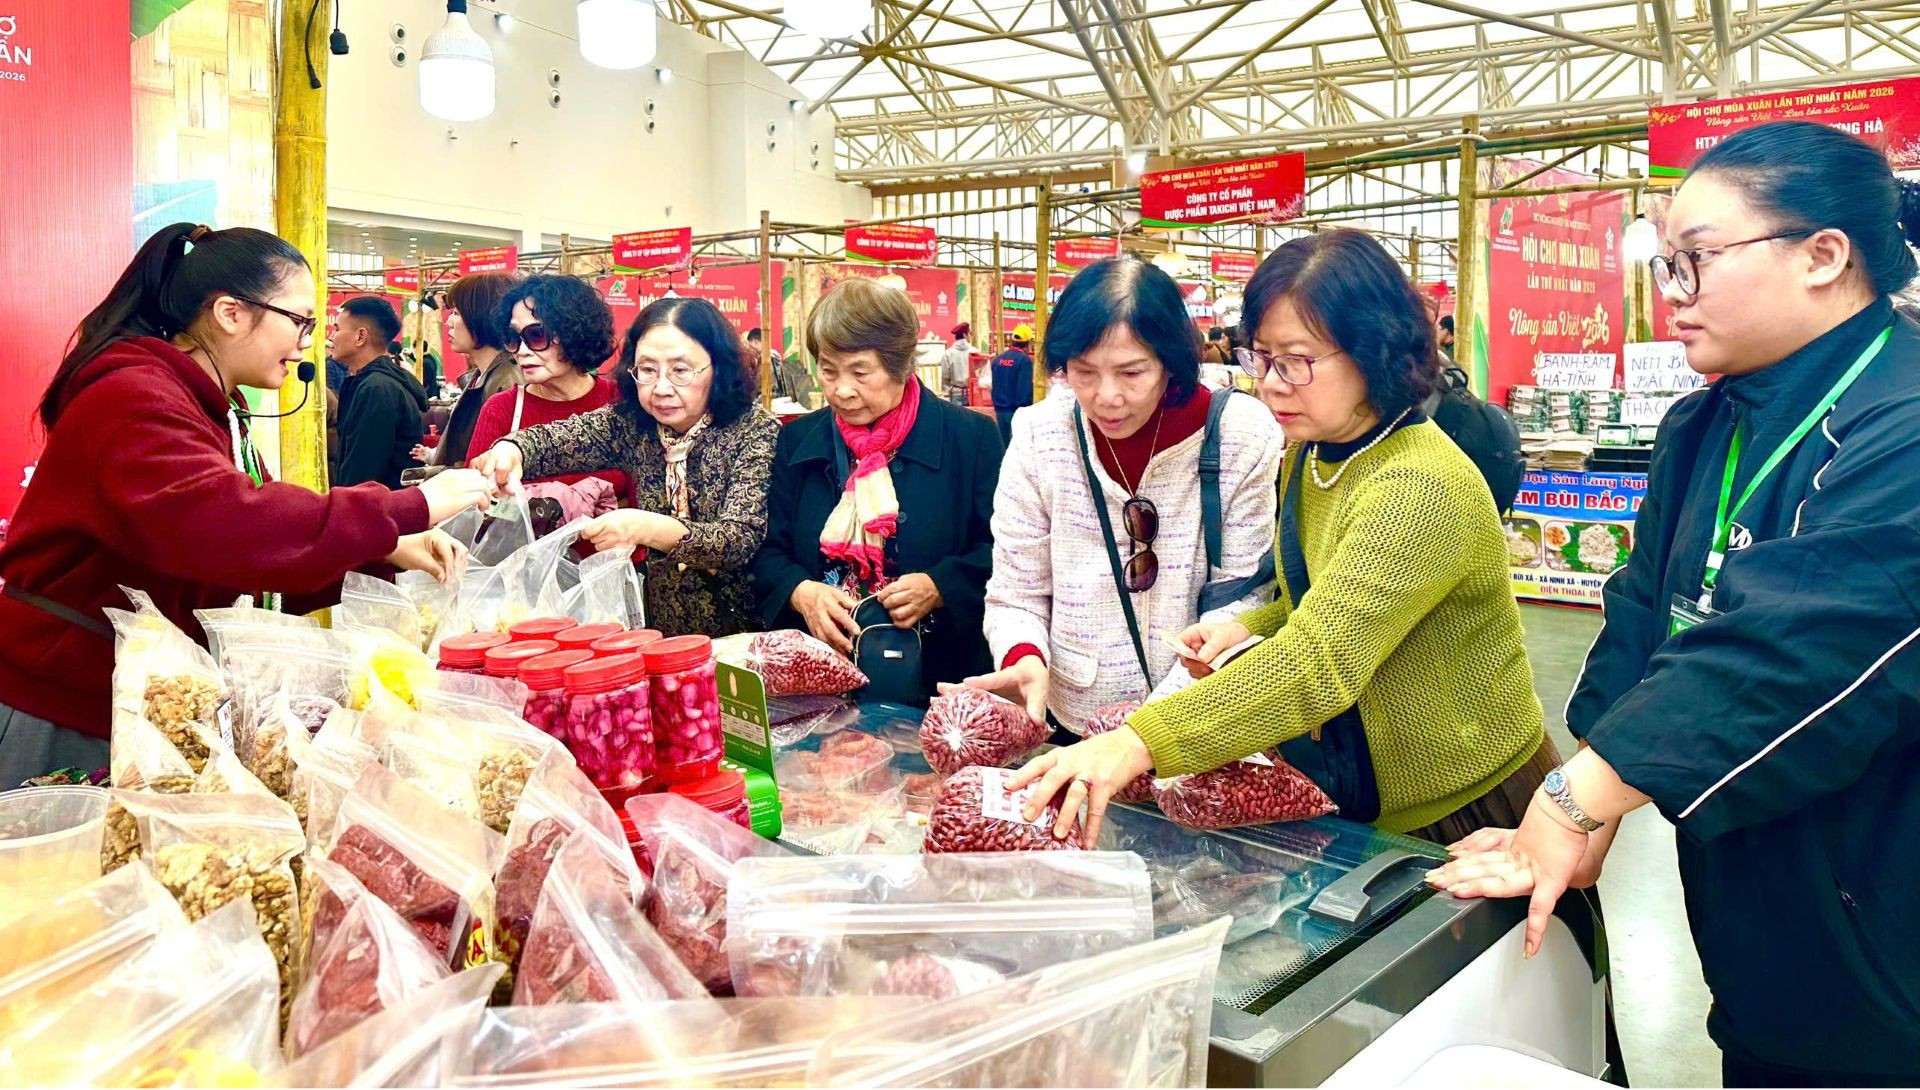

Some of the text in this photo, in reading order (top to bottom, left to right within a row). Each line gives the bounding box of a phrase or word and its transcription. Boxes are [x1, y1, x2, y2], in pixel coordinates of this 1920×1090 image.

[1687, 107, 1701, 119] HỘI
[1703, 105, 1722, 117] CHỢ
[1724, 103, 1745, 114] MÙA
[1747, 99, 1772, 111] XUÂN
[1774, 95, 1793, 108] LẦN
[1815, 91, 1842, 104] NHẤT
[1843, 88, 1867, 101] NĂM
[1869, 86, 1895, 98] 2026
[1705, 116, 1732, 127] Nông
[1841, 101, 1870, 112] Xuân
[1864, 116, 1884, 134] HÀ
[1186, 192, 1208, 205] CÔNG
[1209, 191, 1217, 202] TY
[1208, 202, 1238, 215] TAKICHI
[1239, 199, 1256, 213] VIỆT
[1257, 198, 1276, 210] NAM
[1522, 232, 1538, 269] HỘI
[1540, 238, 1558, 271] CHỢ
[1559, 238, 1578, 268] MÙA
[1579, 241, 1600, 270] XUÂN
[1509, 307, 1540, 345] Nông
[1541, 313, 1558, 336] sản
[1559, 311, 1580, 342] Việt
[1545, 489, 1580, 509] BÙI
[1584, 489, 1628, 511] BẮC
